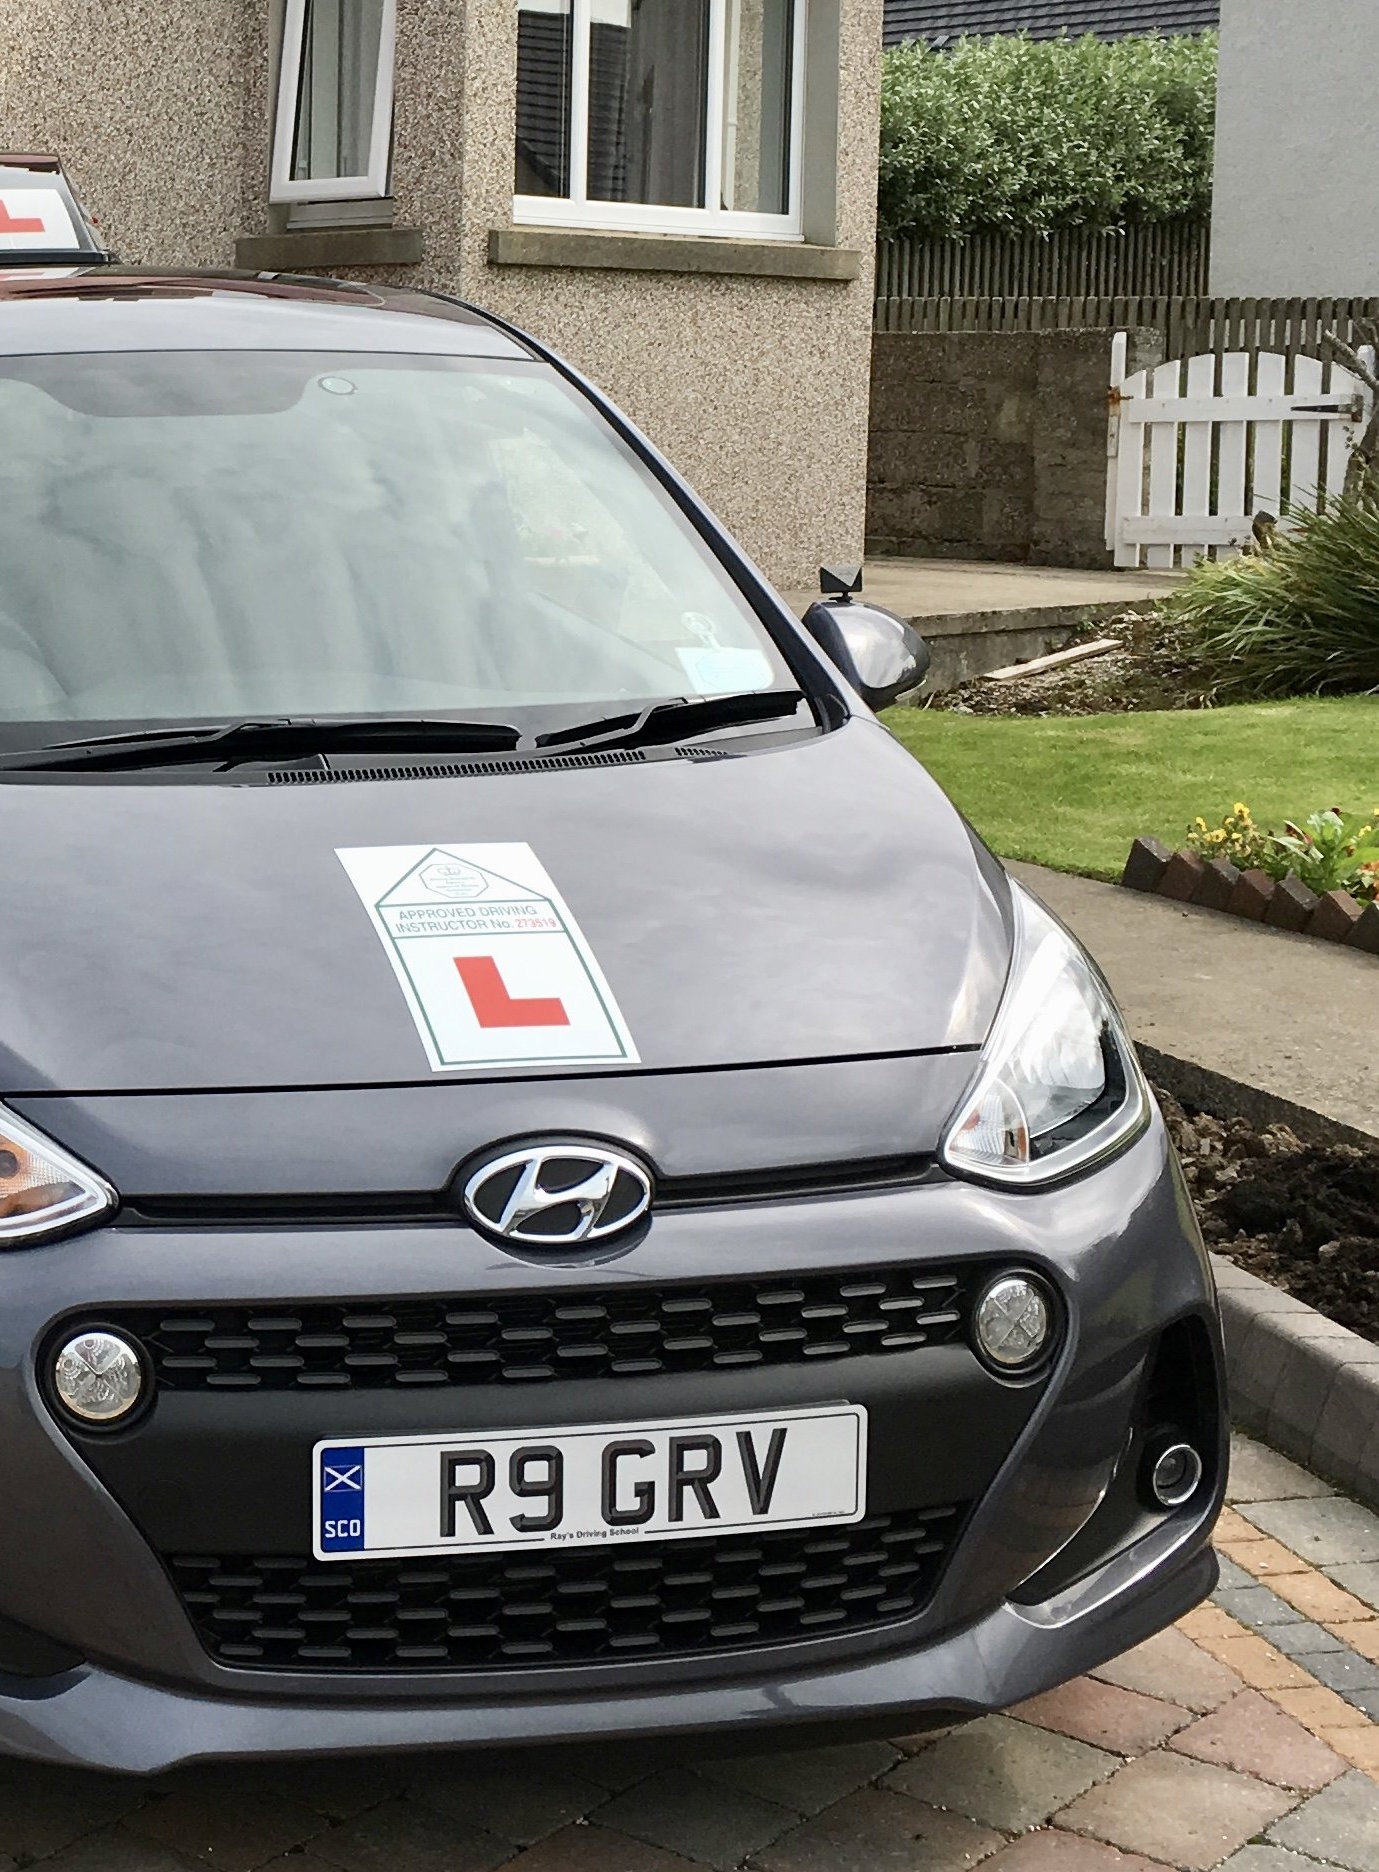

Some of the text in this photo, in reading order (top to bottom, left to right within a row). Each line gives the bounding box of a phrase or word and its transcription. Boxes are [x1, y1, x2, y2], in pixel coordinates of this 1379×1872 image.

[399, 905, 538, 920] APPROVED DRIVING
[396, 919, 488, 933] INSTRUCTOR
[453, 955, 571, 1028] L
[439, 1428, 788, 1538] R9 GRV
[325, 1519, 361, 1538] SCO
[550, 1527, 639, 1541] Ray's Driving School
